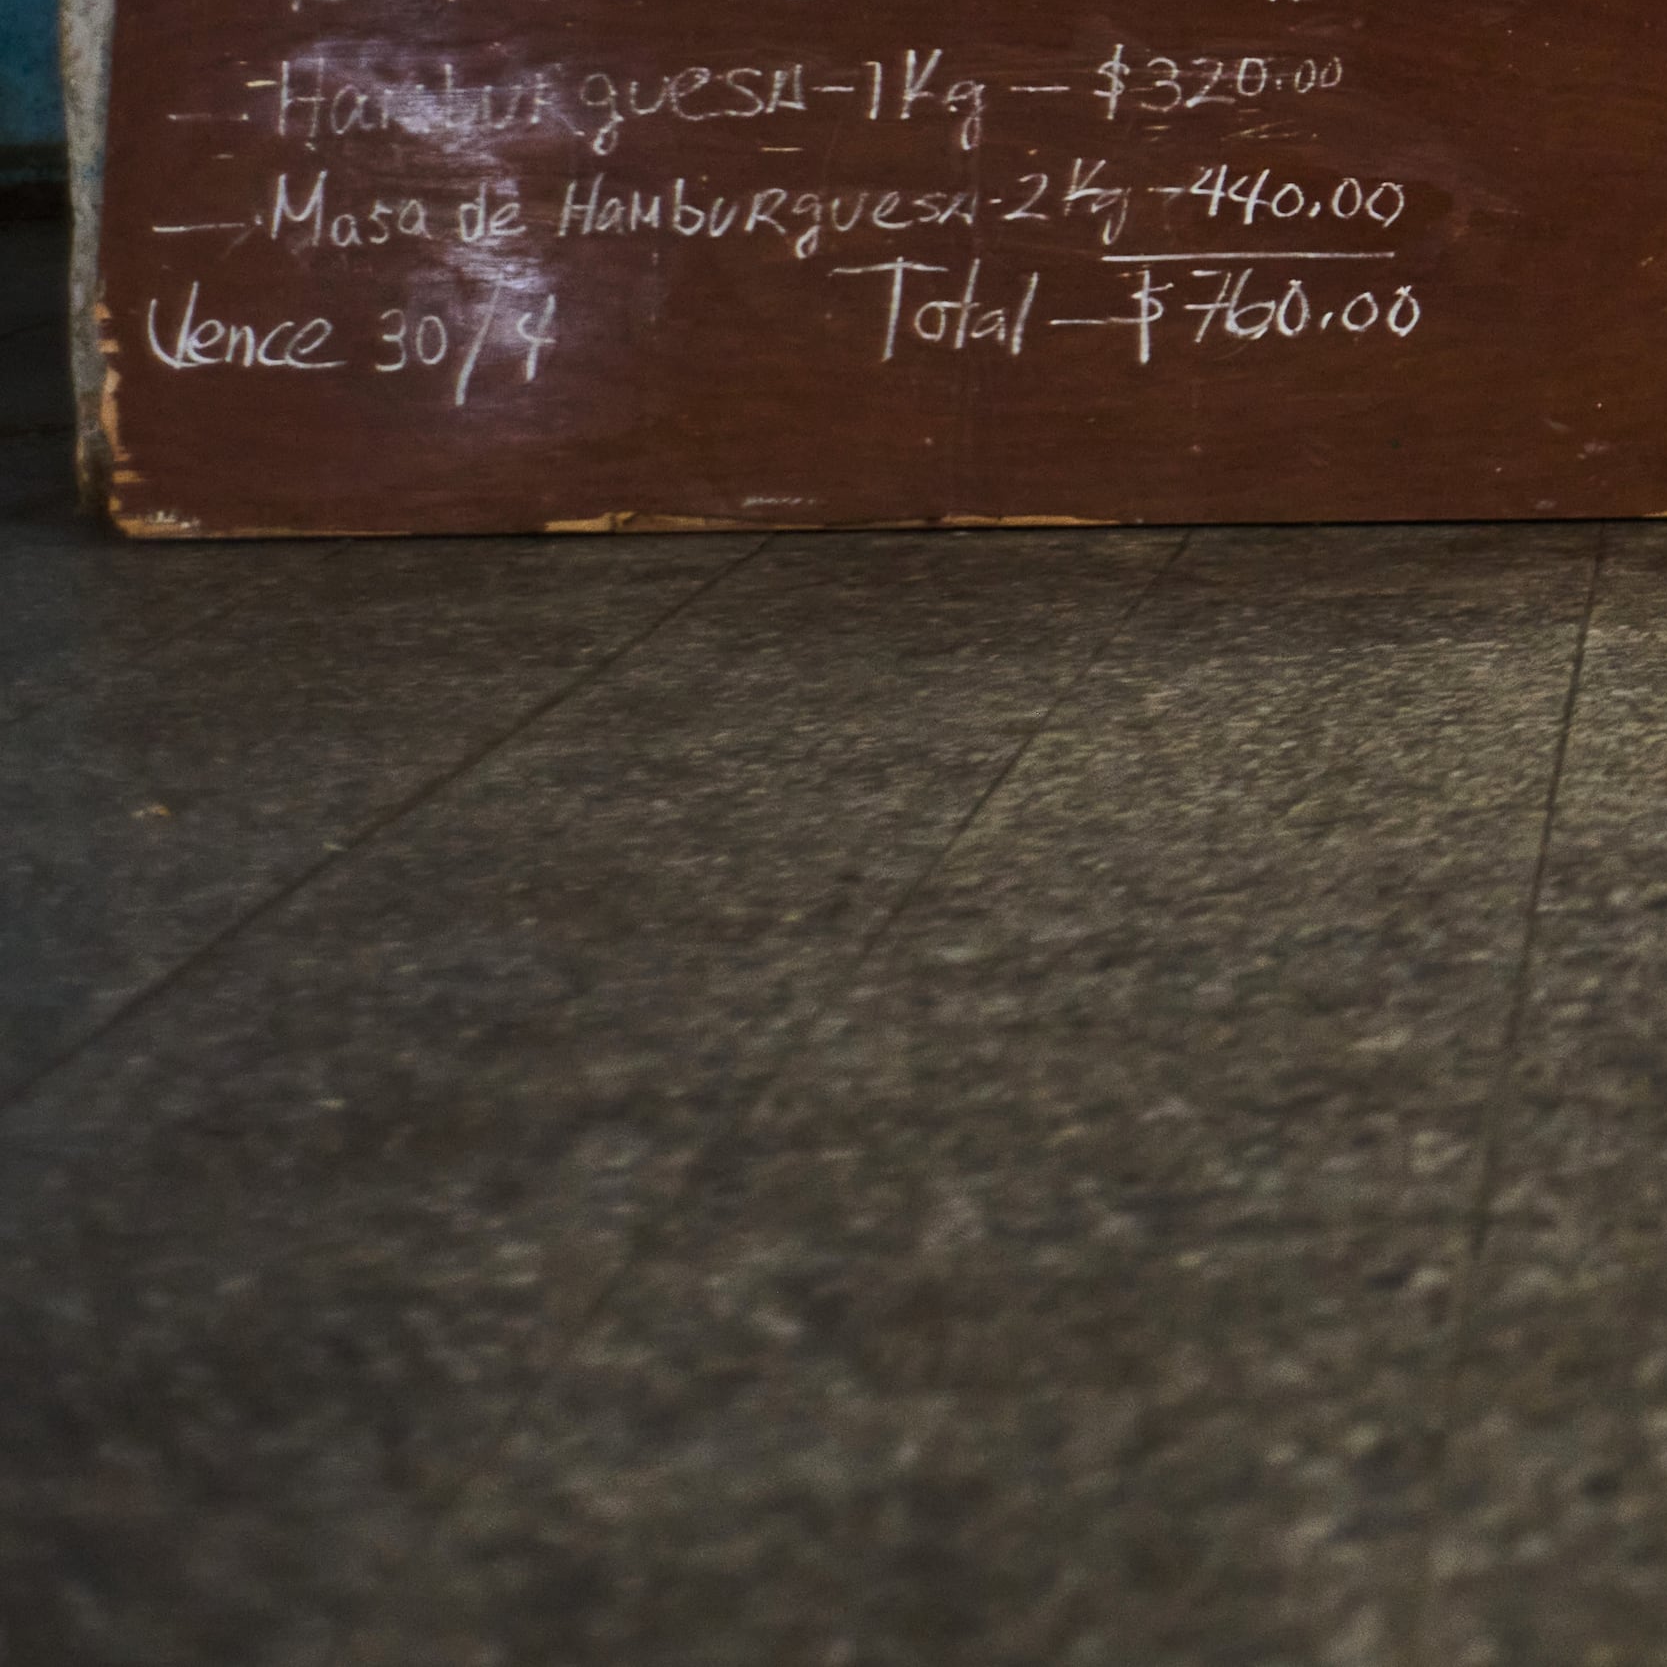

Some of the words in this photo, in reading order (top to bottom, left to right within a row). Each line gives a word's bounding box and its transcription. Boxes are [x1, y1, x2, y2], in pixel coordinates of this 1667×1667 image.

[147, 280, 348, 369] Vence
[374, 281, 558, 407] 30/4
[827, 255, 1040, 362] Total
